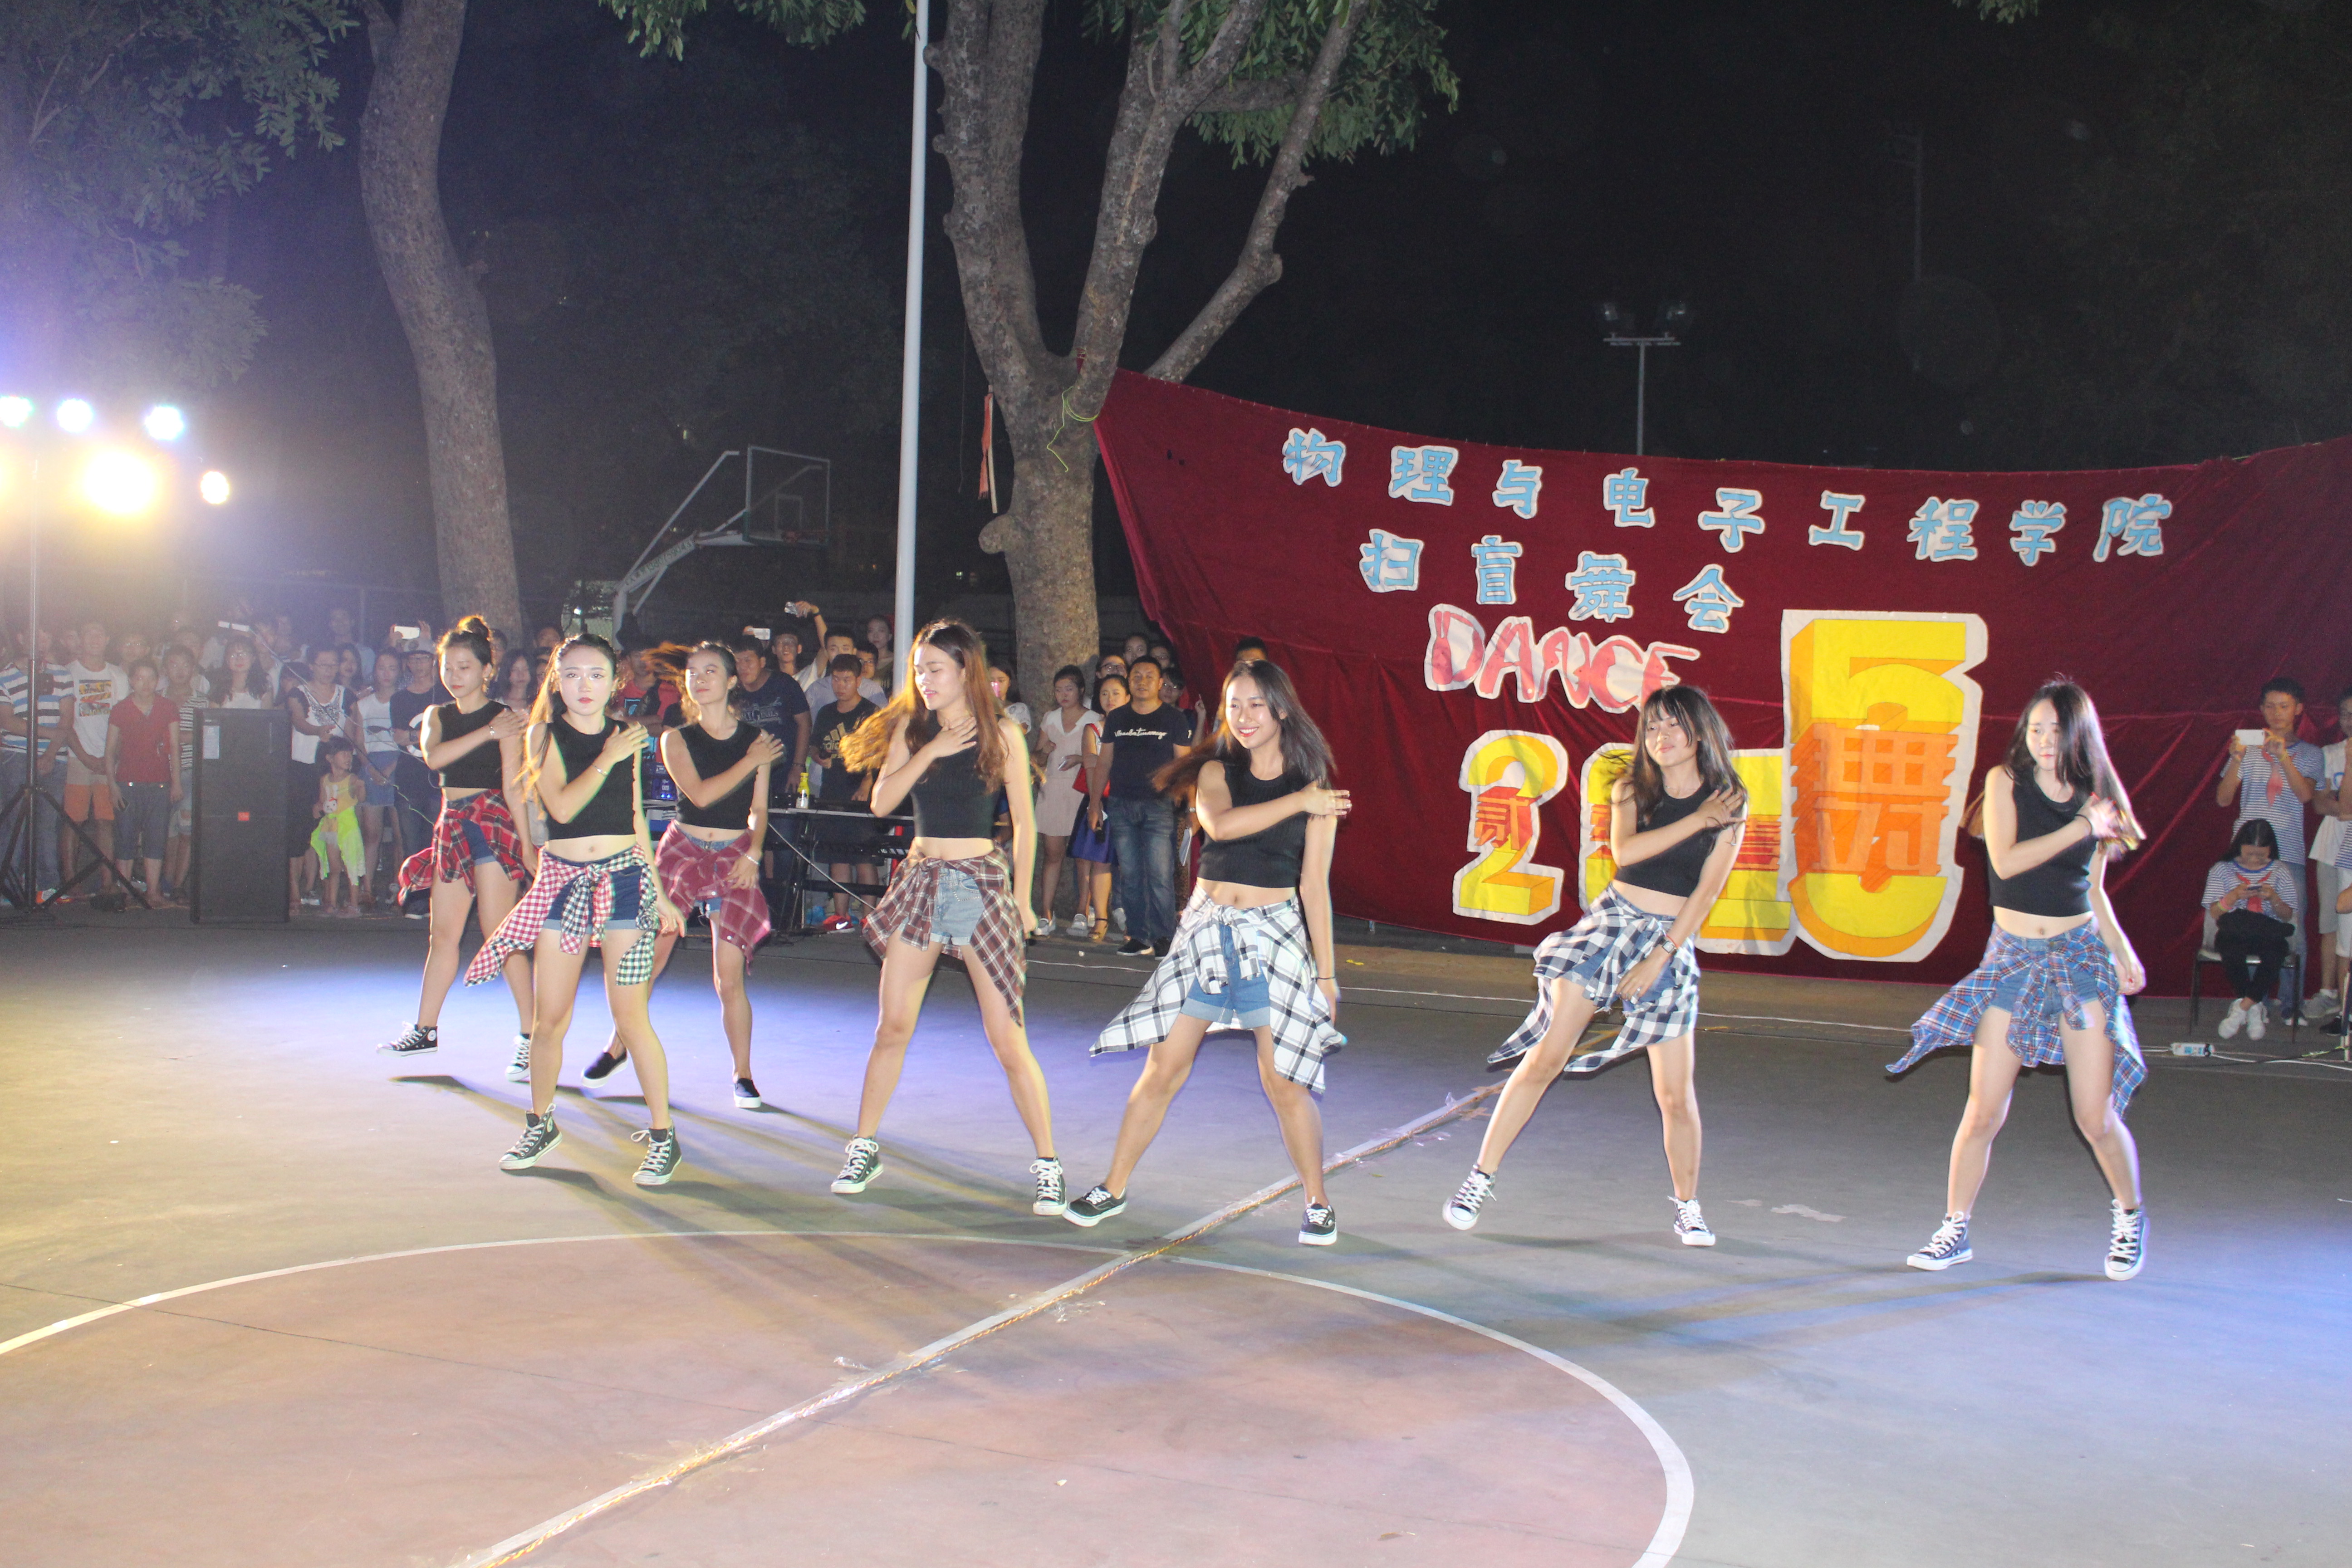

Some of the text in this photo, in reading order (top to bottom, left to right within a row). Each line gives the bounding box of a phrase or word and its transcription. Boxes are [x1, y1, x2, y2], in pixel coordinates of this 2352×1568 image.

[1283, 428, 2172, 564] 物理与电子工程学院
[1361, 531, 1744, 632] 扫盲舞会
[1426, 604, 1700, 708] DANCE
